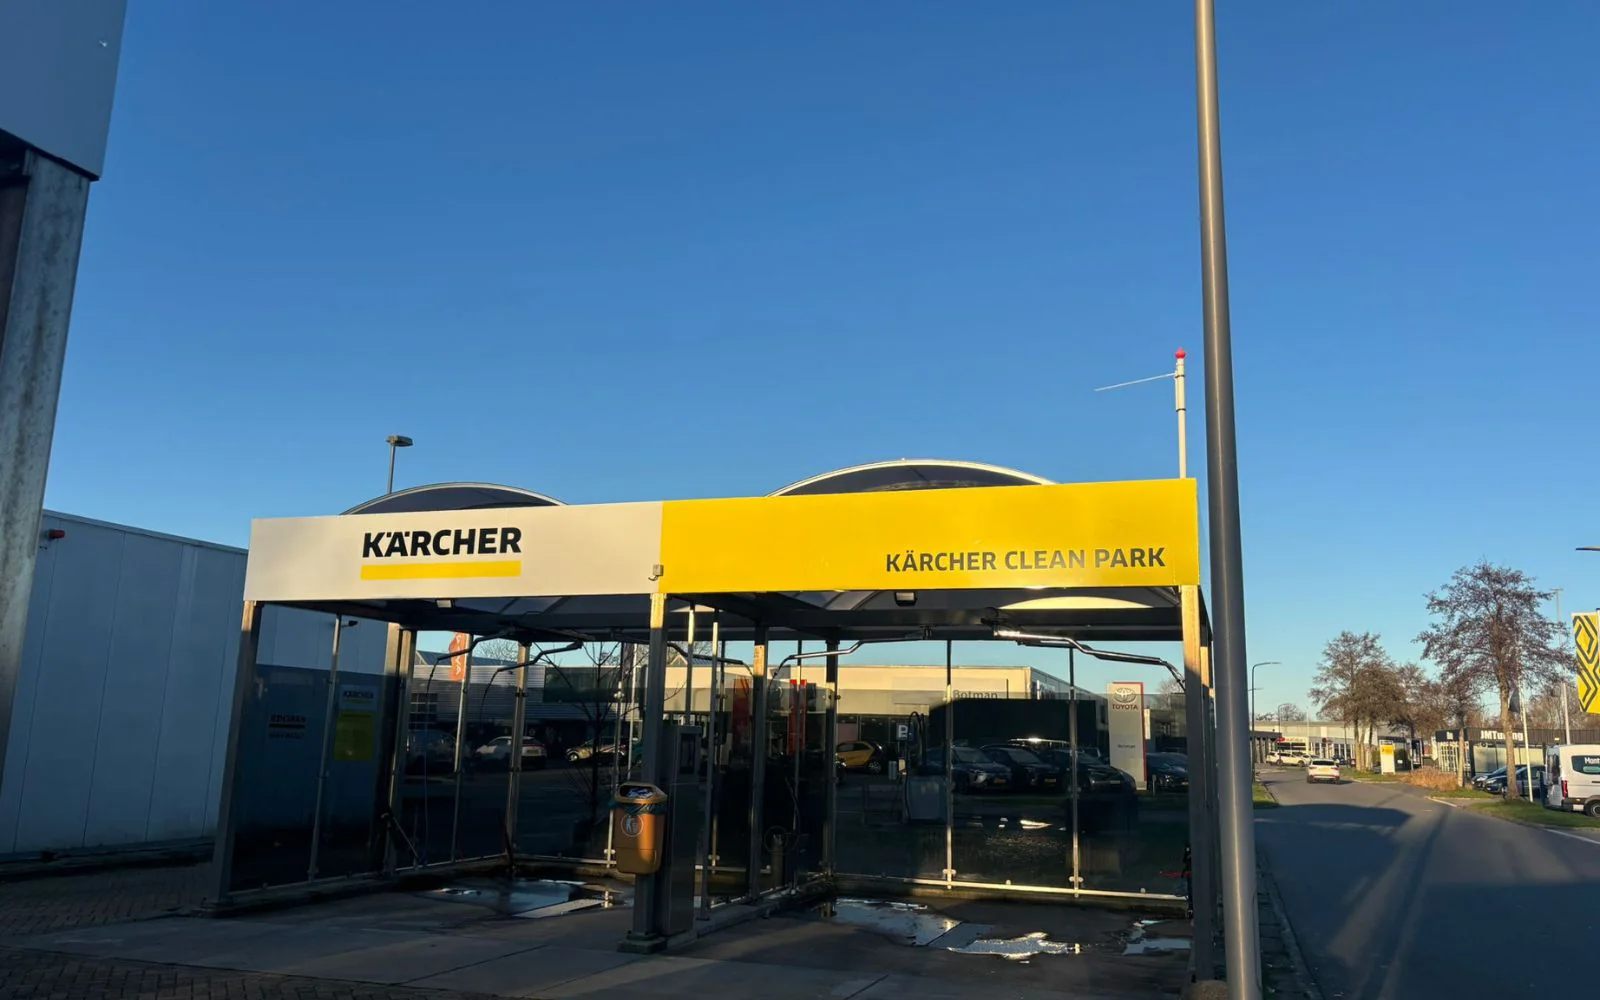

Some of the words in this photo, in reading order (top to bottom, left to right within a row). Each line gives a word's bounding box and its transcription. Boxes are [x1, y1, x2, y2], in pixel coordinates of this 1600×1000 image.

[362, 527, 522, 558] KÄRCHER
[886, 550, 997, 572] KÄRCHER
[1004, 550, 1086, 570] CLEAN
[1094, 547, 1166, 568] PARK
[1480, 730, 1524, 741] JMTung
